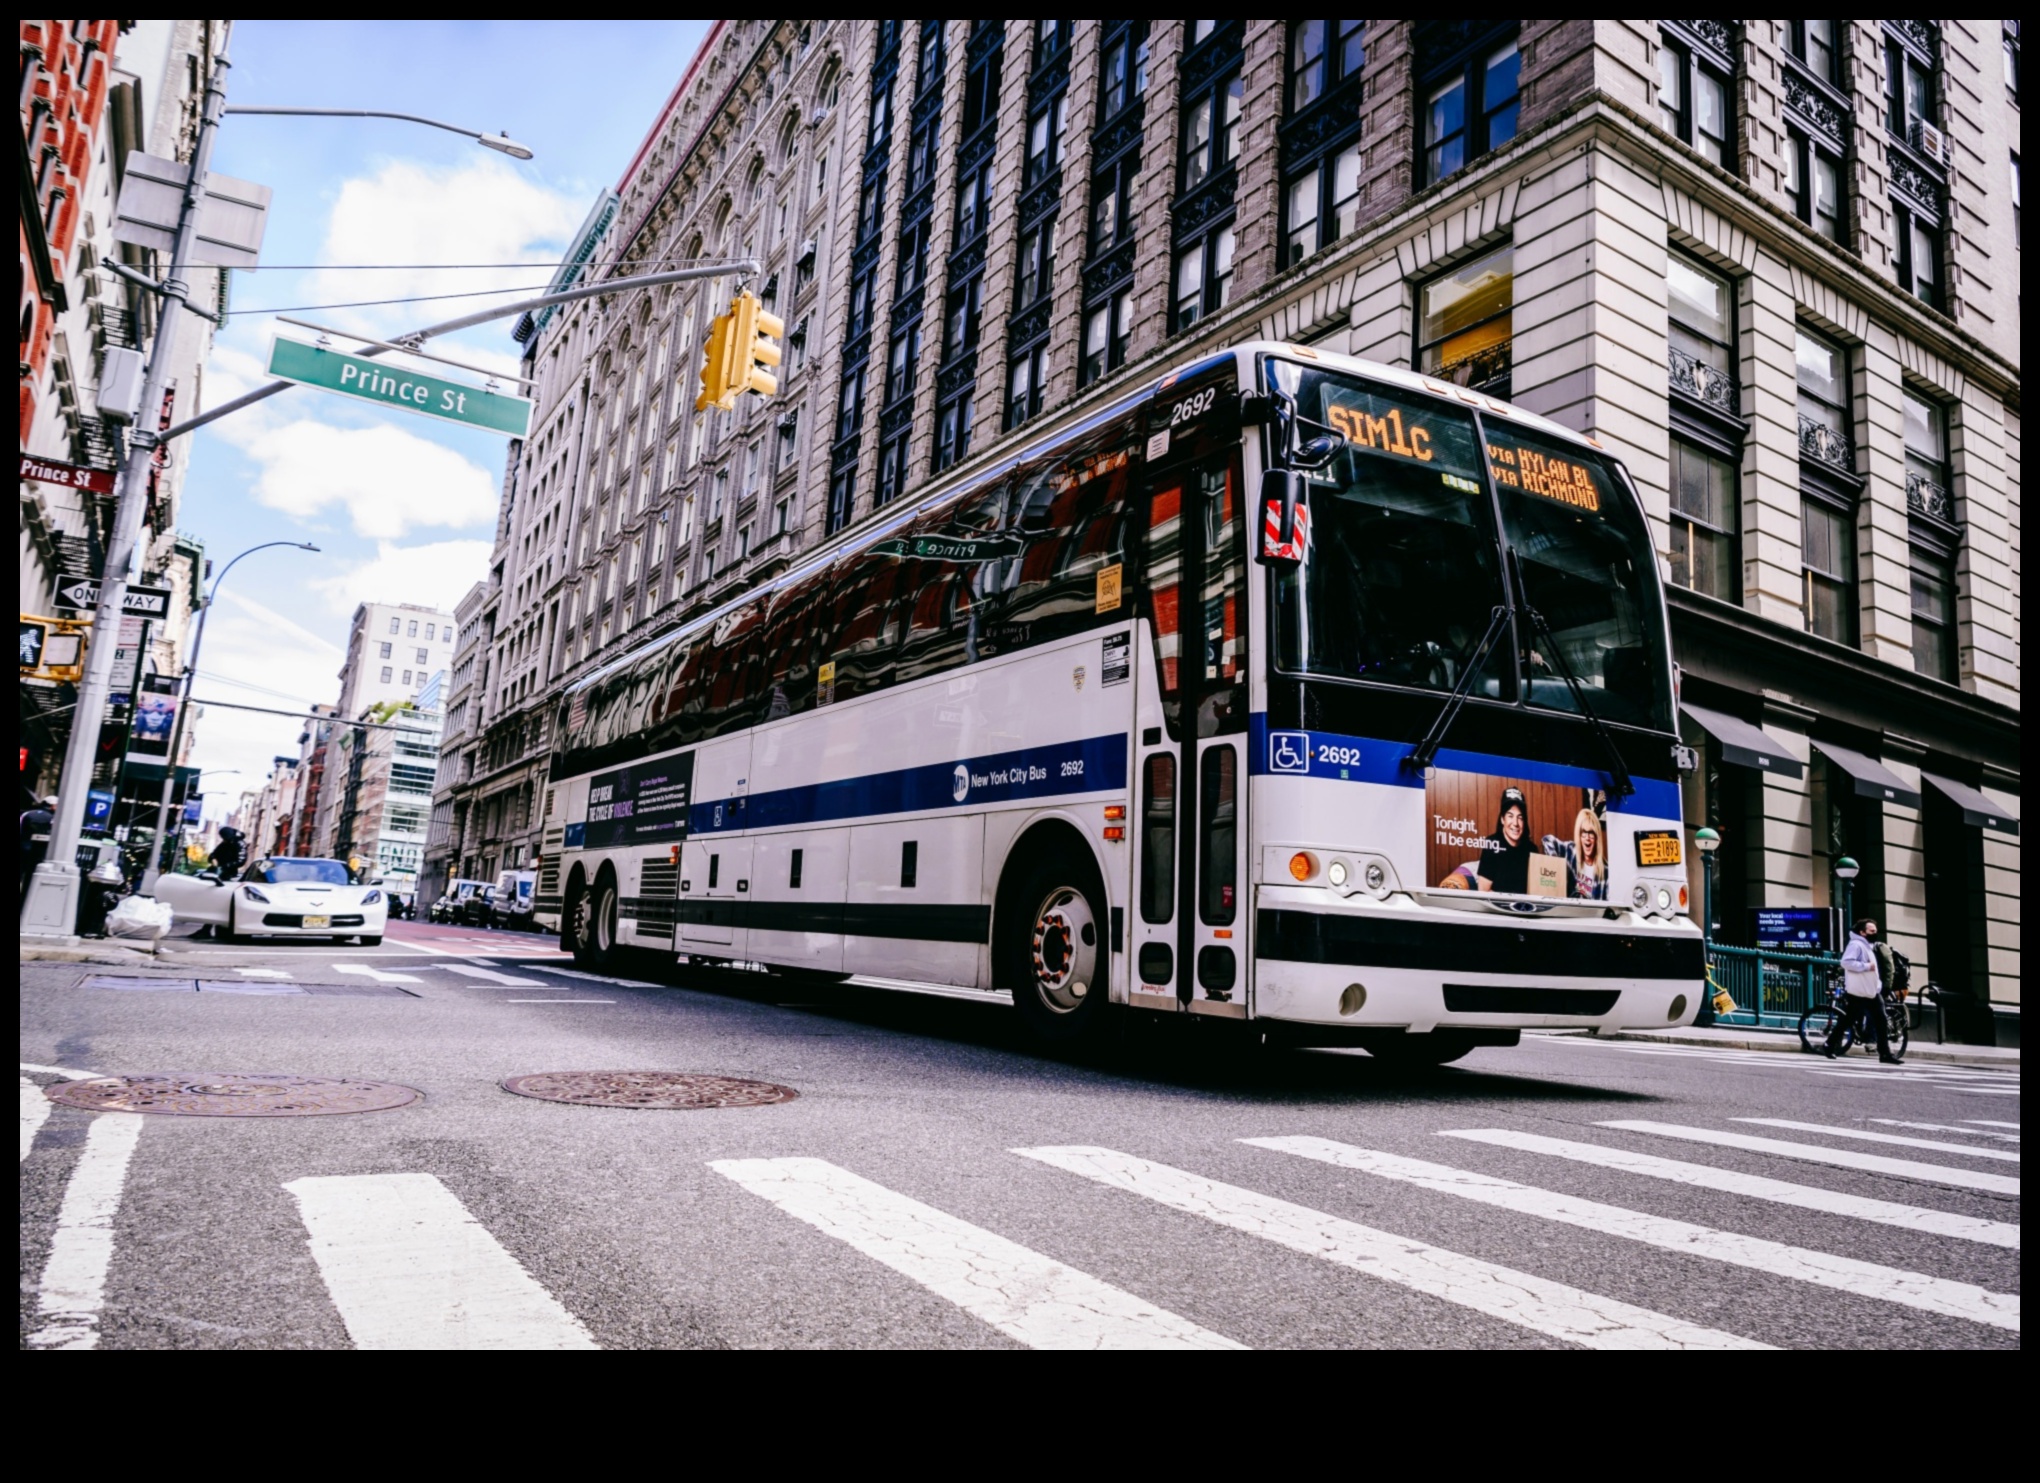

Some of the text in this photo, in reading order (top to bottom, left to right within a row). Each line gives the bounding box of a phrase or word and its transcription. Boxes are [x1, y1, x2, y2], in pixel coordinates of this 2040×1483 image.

[340, 363, 466, 414] Prince St
[1170, 387, 1216, 426] 2692
[20, 459, 91, 487] Prince St
[1486, 444, 1593, 490] VIA HYLAN BL
[1490, 465, 1598, 512] VIA RICHMOND
[1319, 744, 1361, 766] 2692
[971, 774, 989, 788] New
[990, 770, 1008, 785] York
[1009, 768, 1027, 784] City
[1029, 766, 1047, 780] Bus
[1060, 760, 1084, 776] 2692
[1434, 815, 1478, 833] Tonight,
[1436, 832, 1447, 845] I'll
[1448, 832, 1464, 846] be
[1540, 867, 1557, 877] Uber
[1540, 879, 1557, 887] Eats
